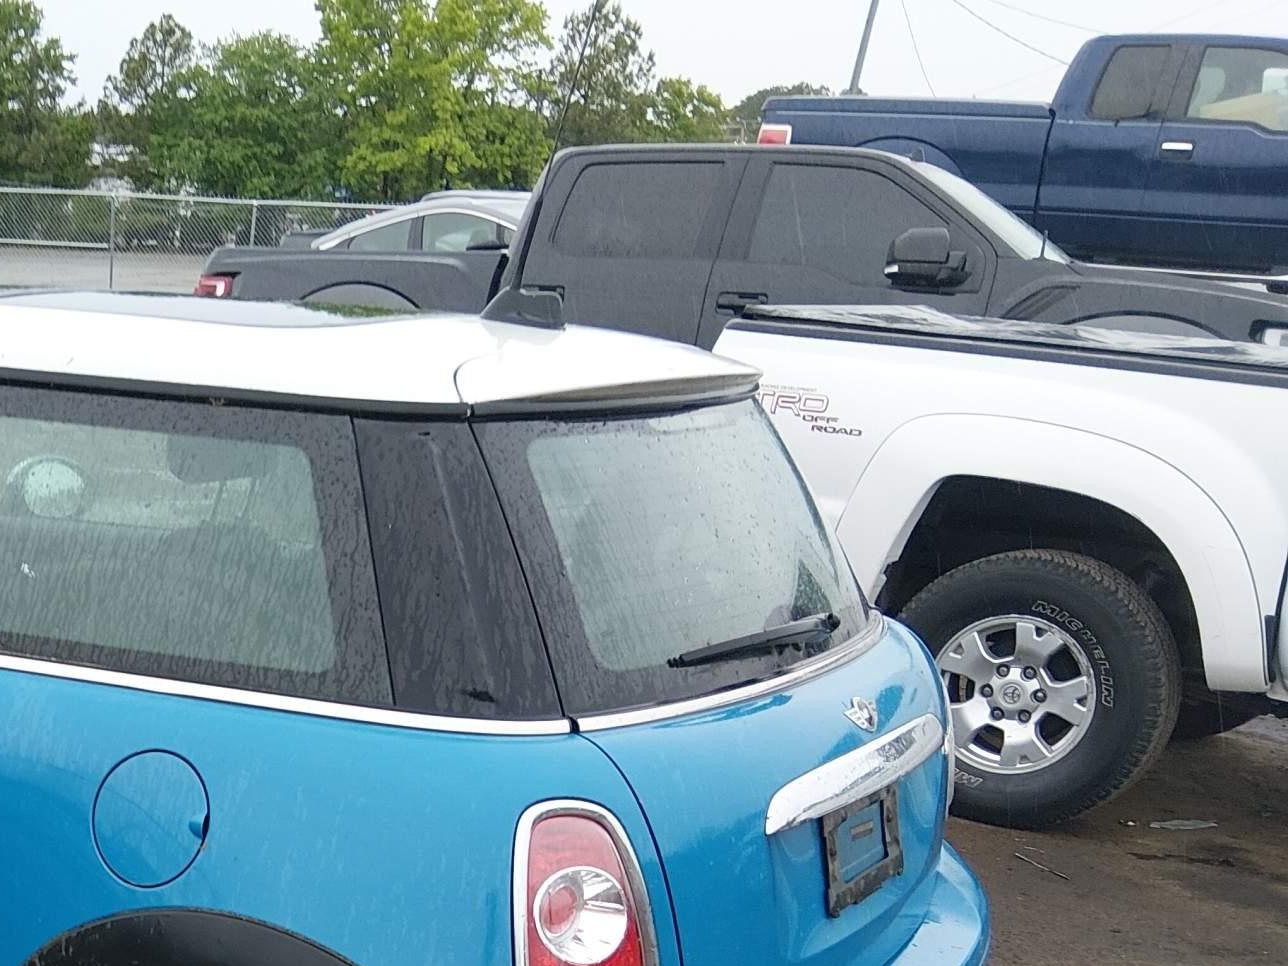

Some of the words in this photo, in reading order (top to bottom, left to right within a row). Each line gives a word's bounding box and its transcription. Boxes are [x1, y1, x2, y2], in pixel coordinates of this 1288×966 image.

[758, 390, 830, 417] TRD
[802, 414, 840, 424] OFF
[811, 424, 863, 437] ROAD
[1032, 600, 1114, 708] MICHELIN
